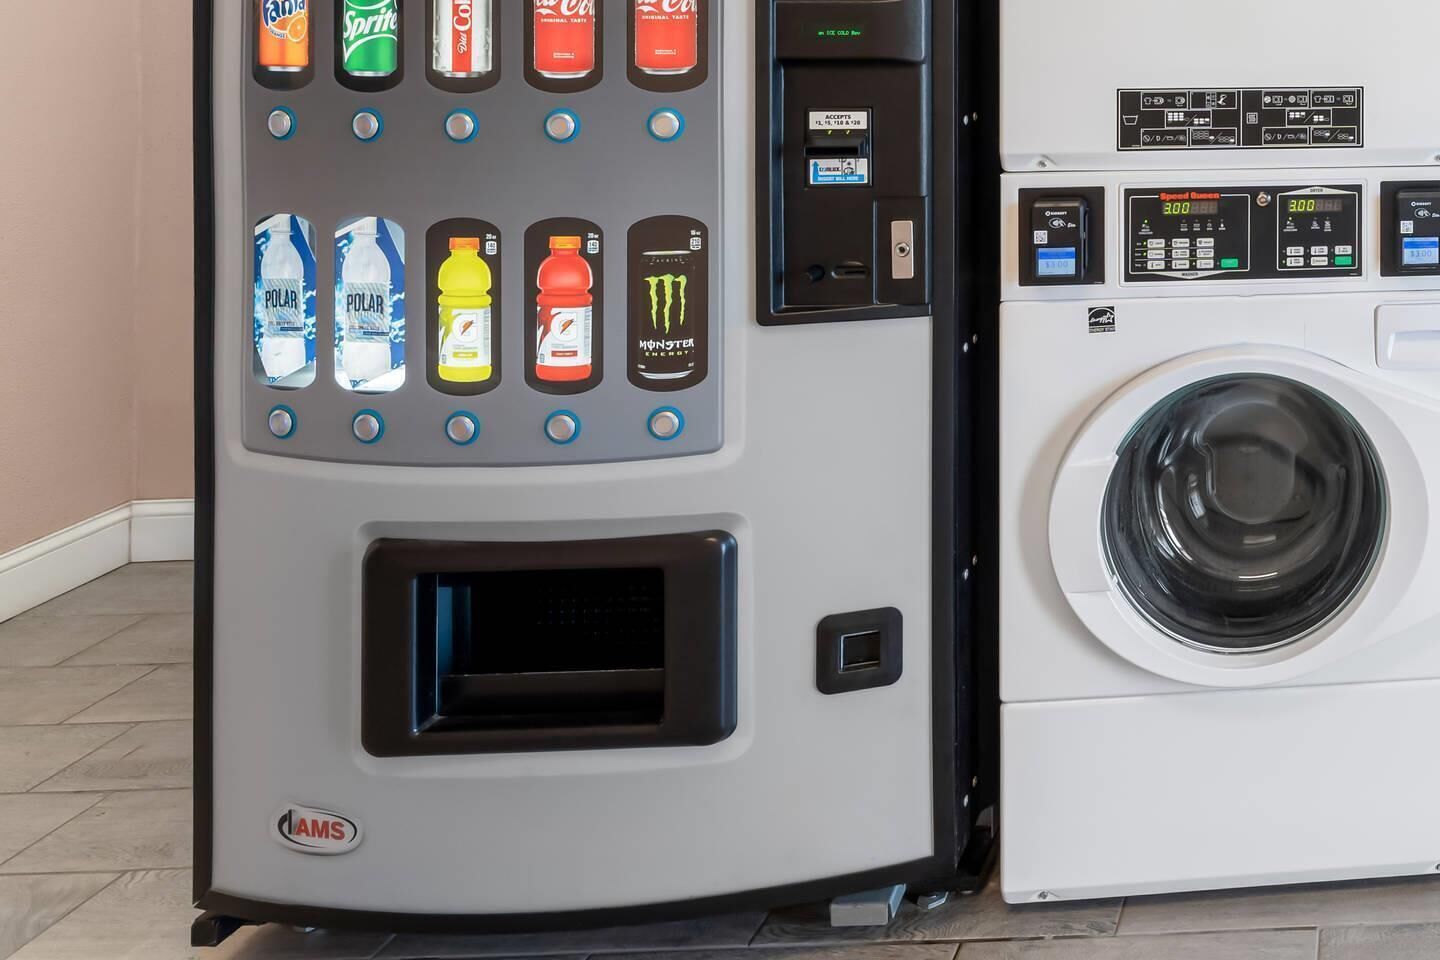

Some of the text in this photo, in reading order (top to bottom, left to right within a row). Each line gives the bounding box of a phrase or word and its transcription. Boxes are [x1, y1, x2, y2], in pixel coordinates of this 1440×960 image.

[343, 7, 398, 41] Sprite
[1159, 192, 1220, 200] Speed Queen
[266, 288, 298, 310] POLAR
[346, 293, 384, 314] POLAR
[640, 338, 694, 350] MONSTER
